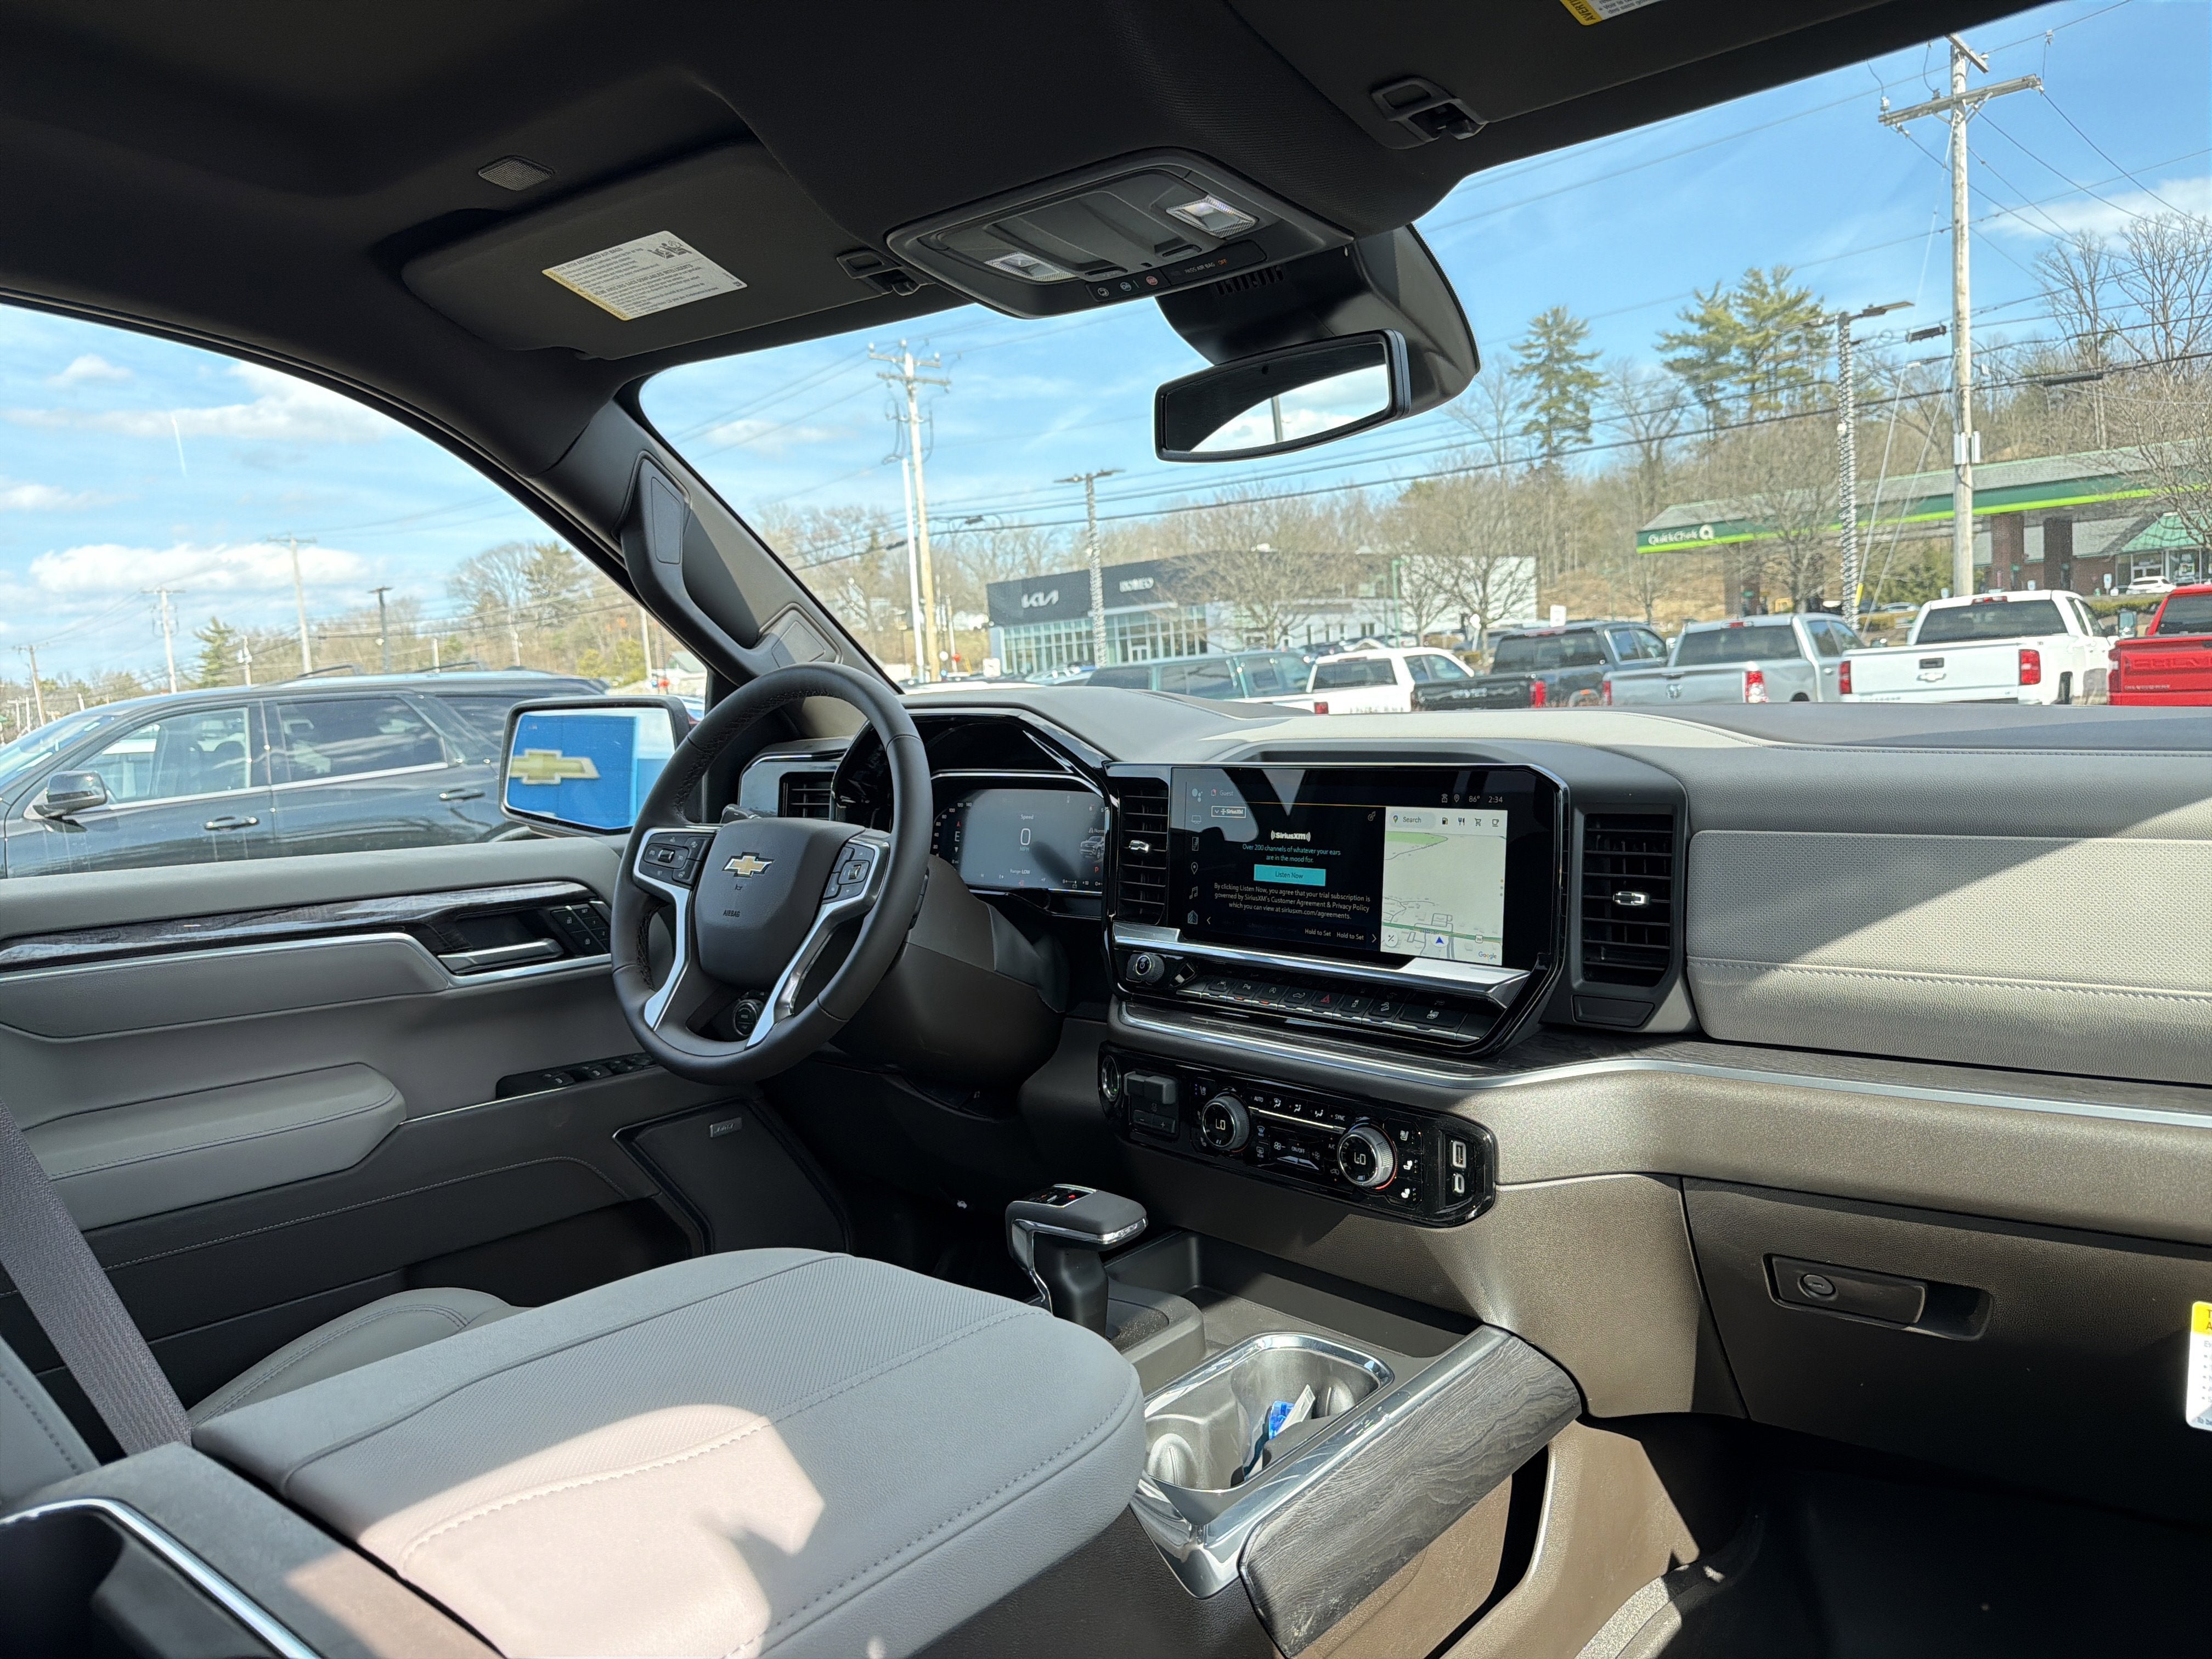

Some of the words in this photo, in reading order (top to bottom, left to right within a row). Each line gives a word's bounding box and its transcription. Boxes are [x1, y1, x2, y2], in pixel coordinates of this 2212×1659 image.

[955, 831, 960, 842] E
[1020, 828, 1031, 845] 0
[1221, 883, 1239, 892] clicking
[1330, 893, 1364, 902] subscription
[1244, 894, 1270, 902] SiriusXM's
[1271, 896, 1295, 905] Customer
[1332, 902, 1352, 911] Privacy
[1352, 904, 1370, 913] Policy
[1281, 908, 1351, 919] siriusxm.com/agreements.
[1478, 951, 1497, 960] Google
[1216, 1119, 1225, 1130] LO
[1354, 1152, 1365, 1165] LO
